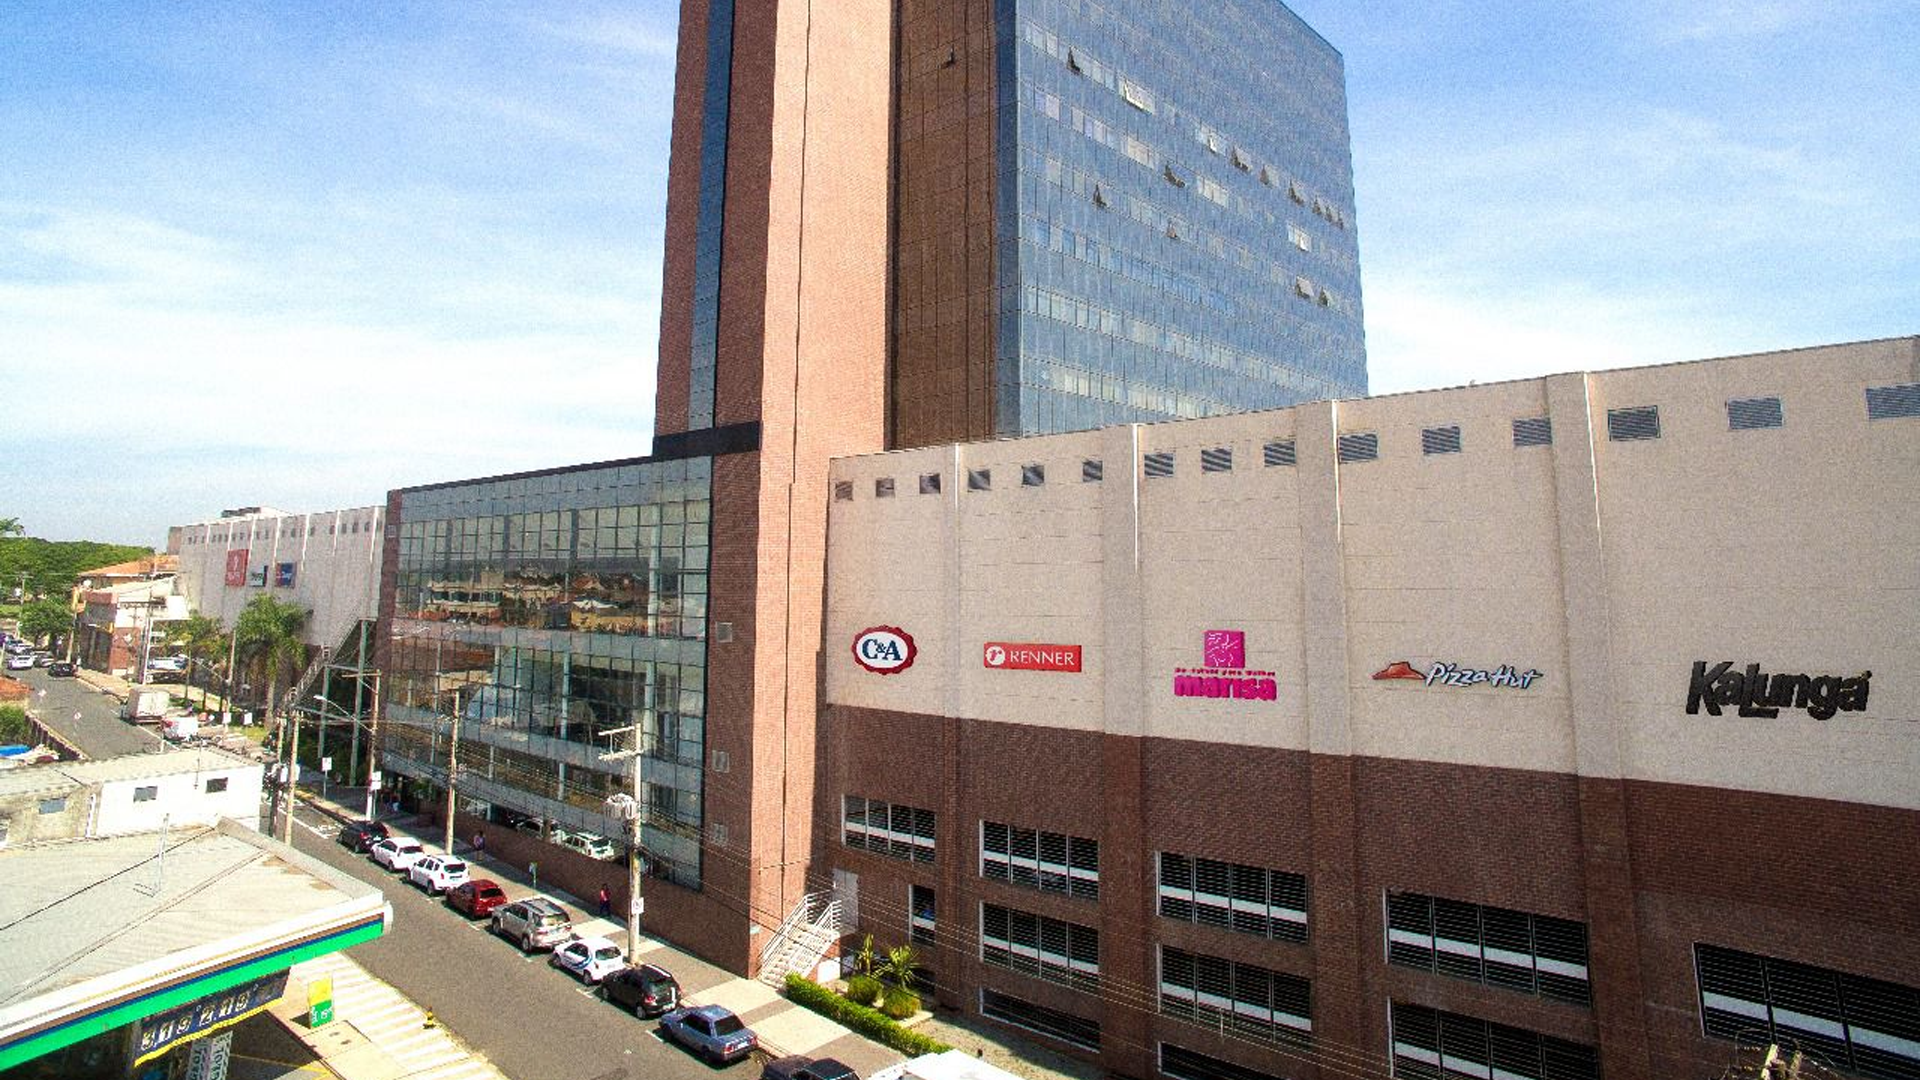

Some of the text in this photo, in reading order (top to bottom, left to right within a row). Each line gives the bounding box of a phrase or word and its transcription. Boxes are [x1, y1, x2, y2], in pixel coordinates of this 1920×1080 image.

[862, 638, 903, 661] C&A
[1010, 650, 1075, 666] RENNER
[1174, 675, 1277, 701] marisa
[1425, 661, 1543, 689] Pizza Hut
[1686, 661, 1870, 721] Kalunga
